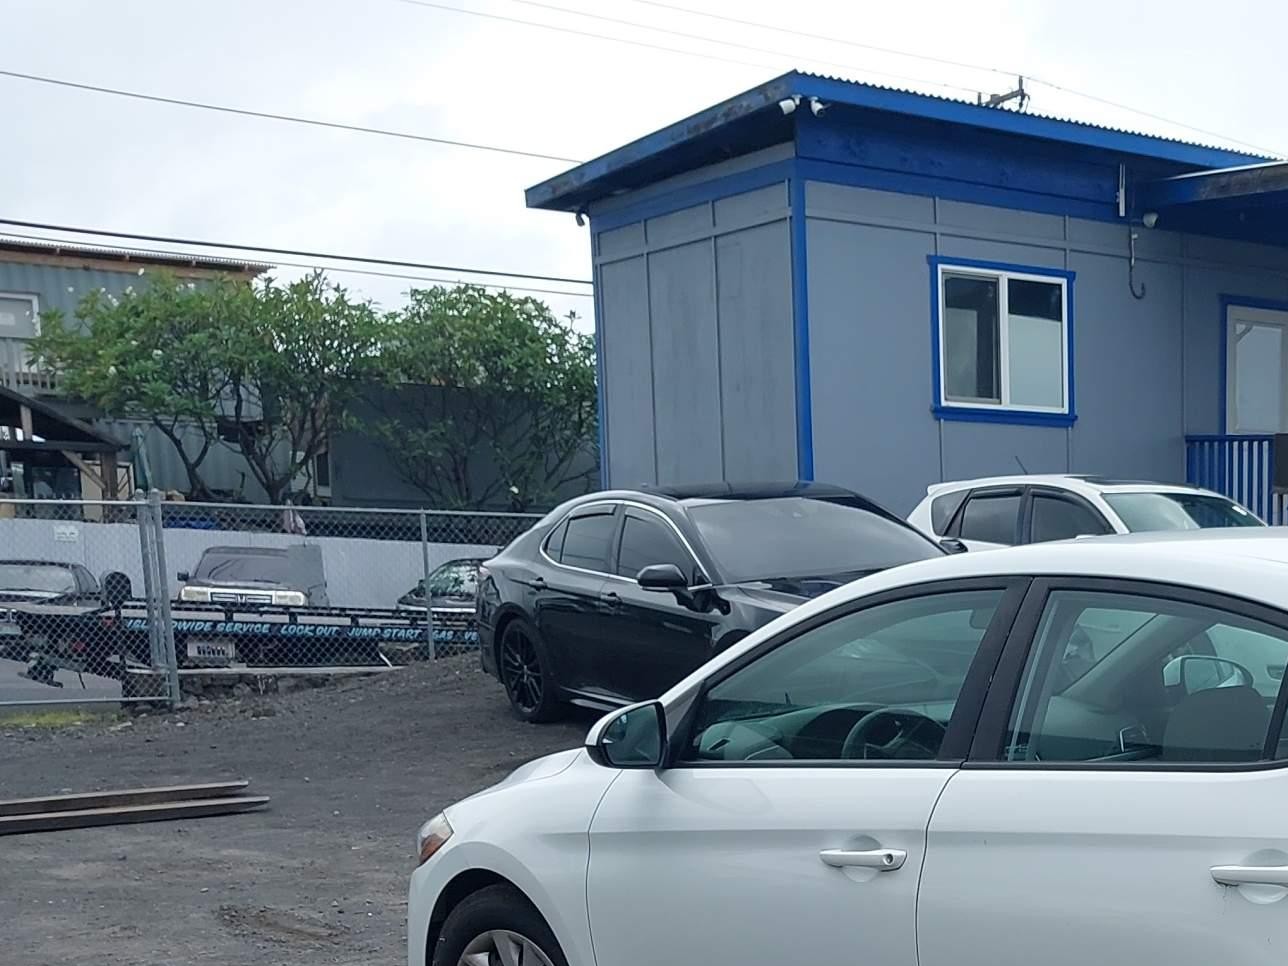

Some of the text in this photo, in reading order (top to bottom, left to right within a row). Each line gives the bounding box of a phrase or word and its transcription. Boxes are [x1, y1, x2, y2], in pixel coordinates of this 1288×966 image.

[127, 619, 213, 631] ISLDWIDE
[216, 622, 271, 633] SERVICE
[316, 626, 340, 636] OUT
[347, 627, 382, 638] JUMP
[383, 629, 423, 639] START
